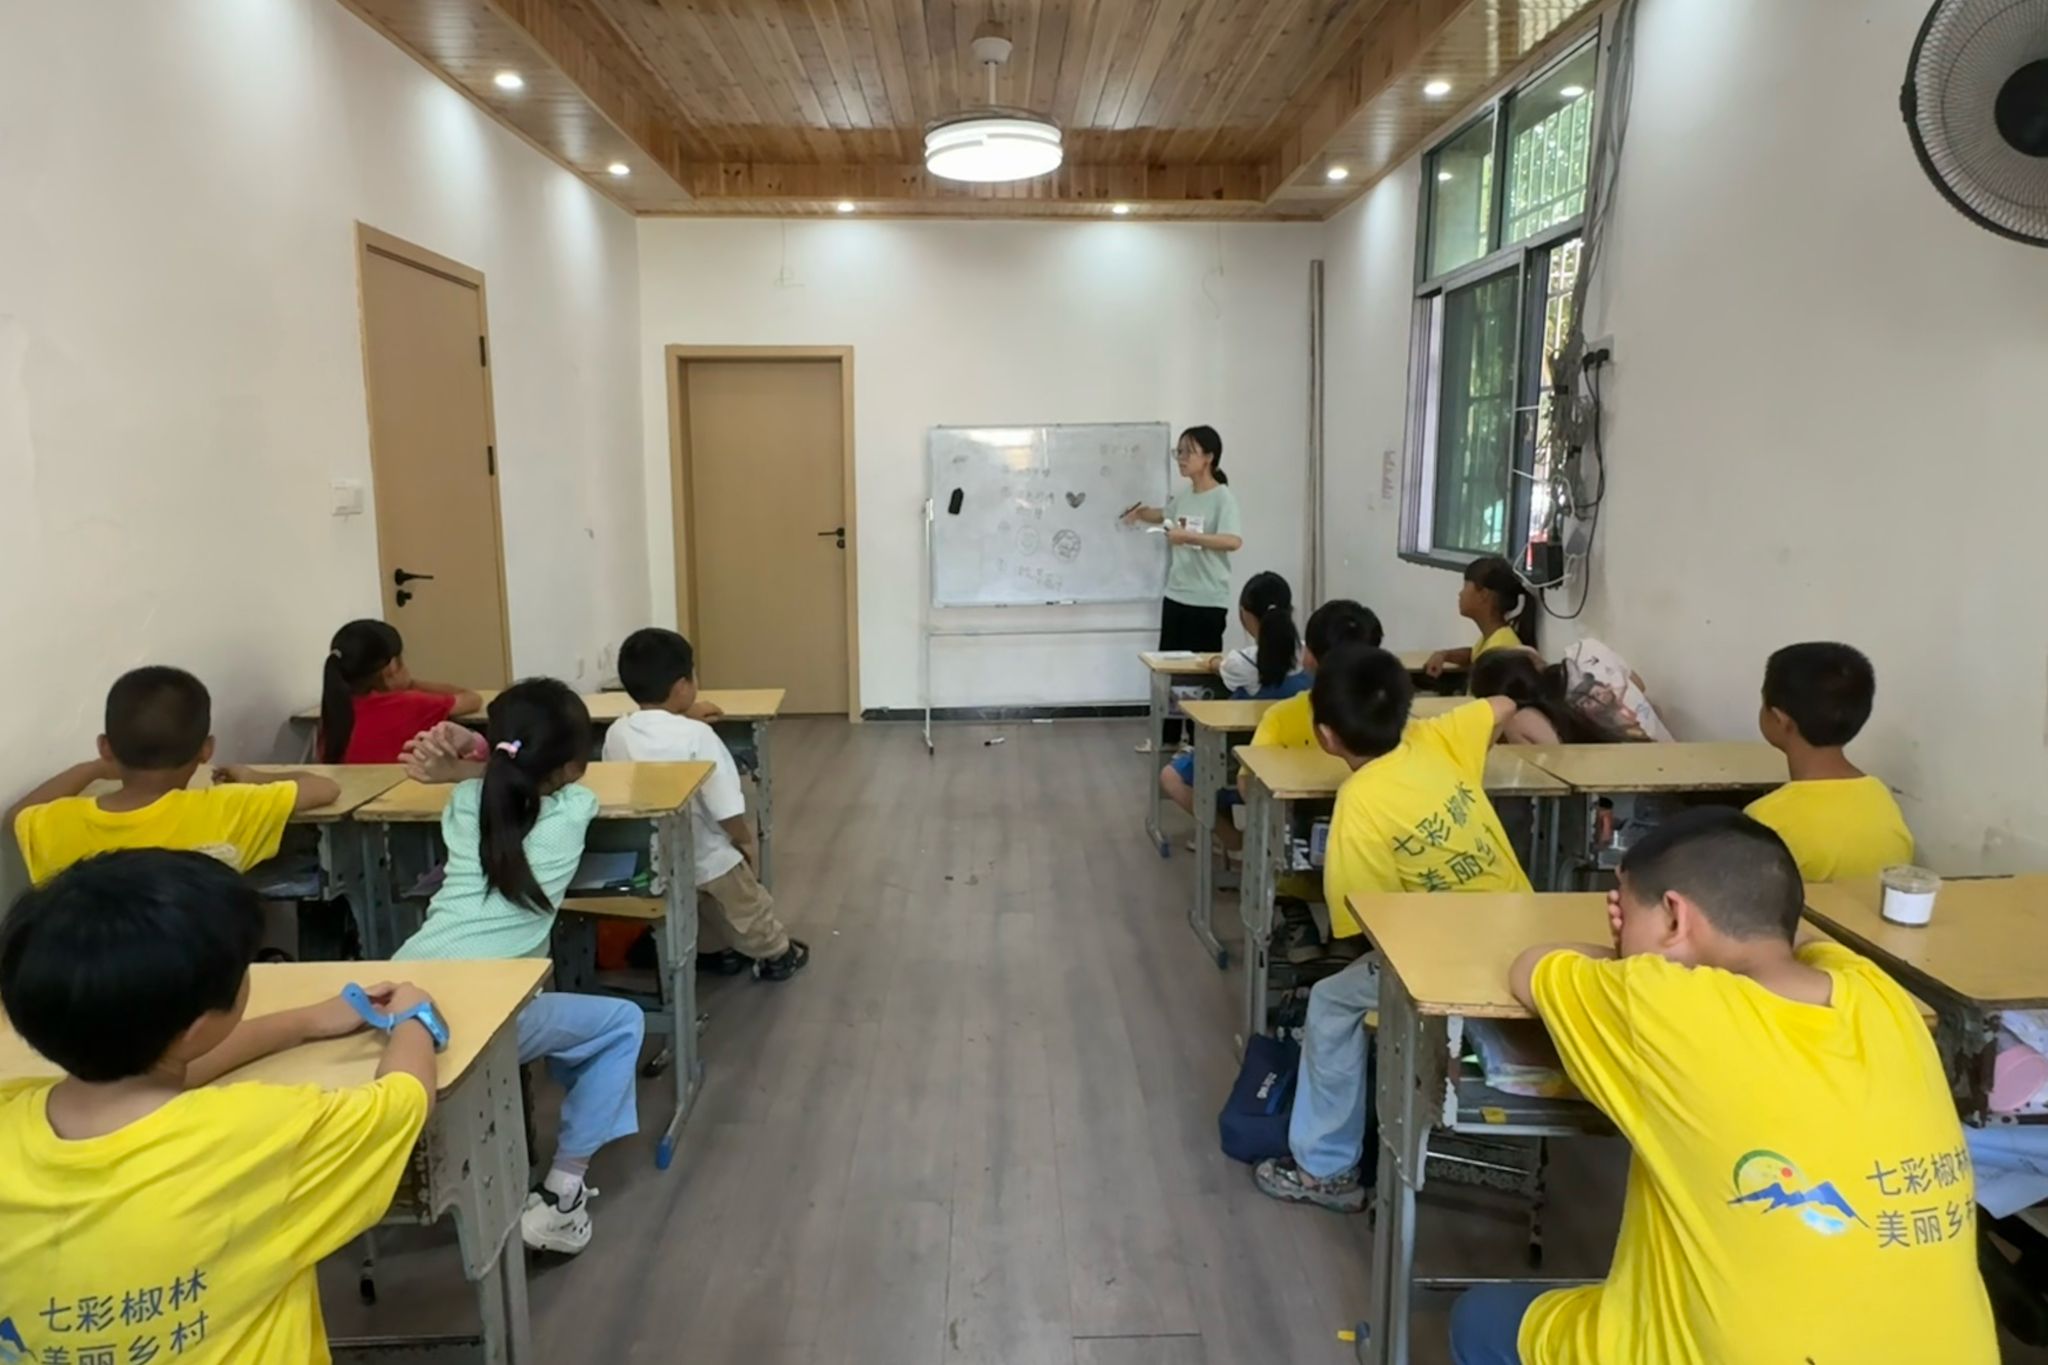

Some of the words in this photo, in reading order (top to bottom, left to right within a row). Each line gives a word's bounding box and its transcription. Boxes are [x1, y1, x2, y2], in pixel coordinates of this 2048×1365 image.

[1417, 823, 1496, 892] 美丽乡
[39, 1268, 207, 1333] 七彩椒林
